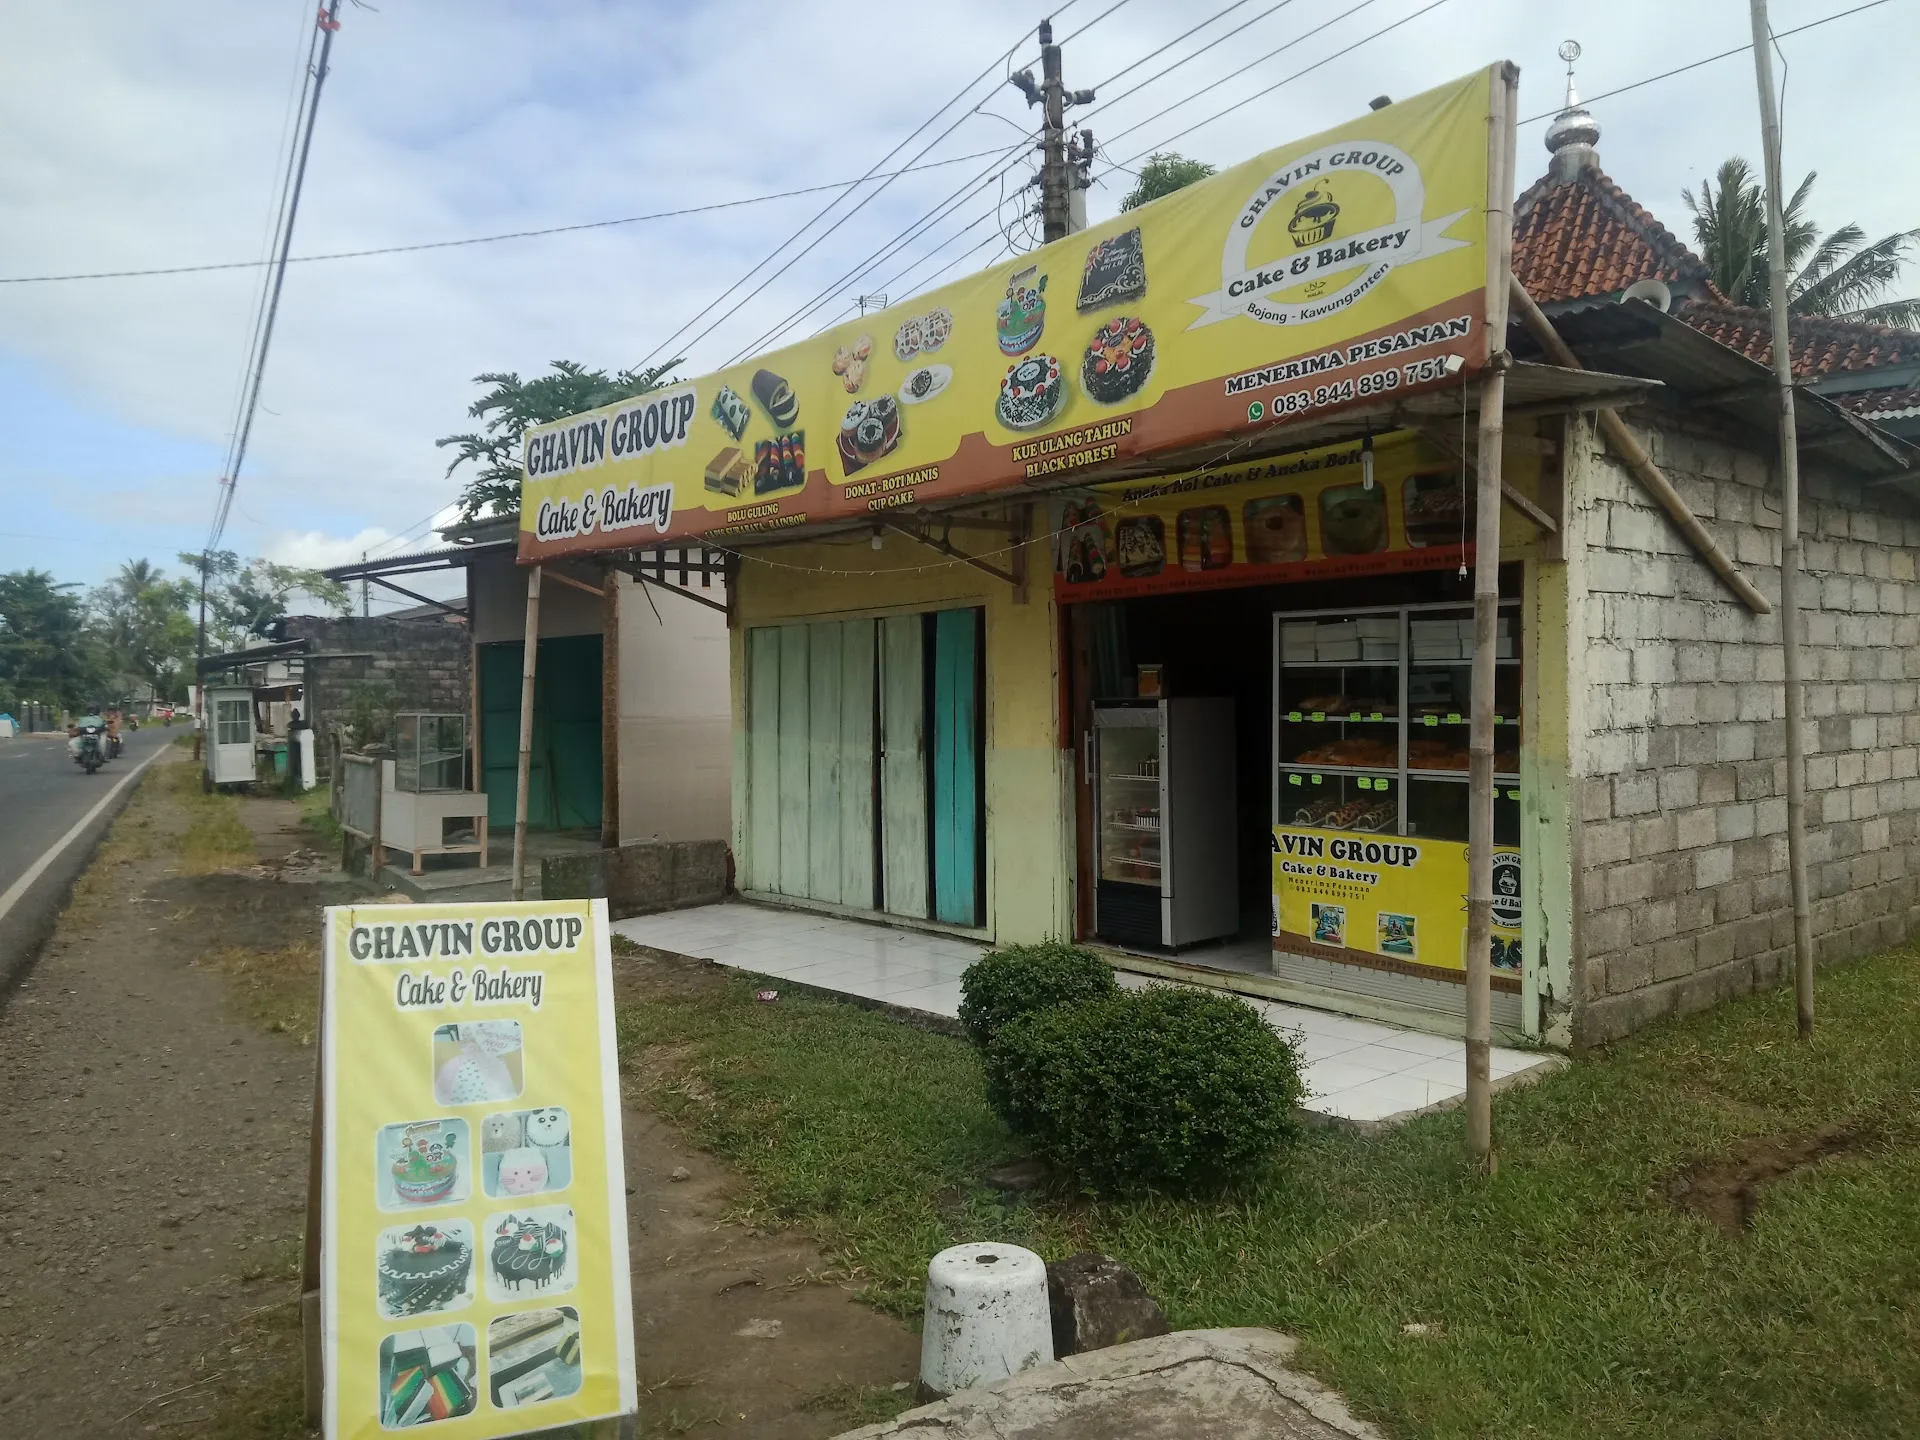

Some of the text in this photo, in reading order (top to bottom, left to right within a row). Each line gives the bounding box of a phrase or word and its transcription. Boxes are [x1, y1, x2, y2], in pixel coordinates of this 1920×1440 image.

[1240, 150, 1405, 229] GHAVIN GROUP
[1228, 228, 1411, 298] Cake & Bakery
[1247, 302, 1288, 325] Bojong
[1300, 261, 1390, 320] Kawunganten
[1226, 317, 1470, 395] MENERIMA PESANAN
[1273, 357, 1446, 415] 083 844 899 751
[528, 393, 695, 476] GHAVIN GROUP
[1012, 419, 1132, 462] KUE ULANG TAHUN
[1026, 443, 1117, 478] BLACK FOREST
[1203, 472, 1243, 488] Cake
[1247, 467, 1263, 481] &
[1265, 458, 1320, 479] Aneka
[845, 482, 877, 499] DONAT
[882, 475, 905, 492] ROTI
[906, 467, 939, 486] MANIS
[868, 490, 914, 511] CUP CAKE
[539, 486, 671, 536] Cake & Bakery
[727, 503, 779, 523] BOLU GULUNG
[1282, 861, 1378, 885] Cake & Bakery
[1330, 839, 1418, 867] GROUP
[349, 917, 582, 961] GHAVIN GROUP
[396, 969, 542, 1007] Cake & Bakery
